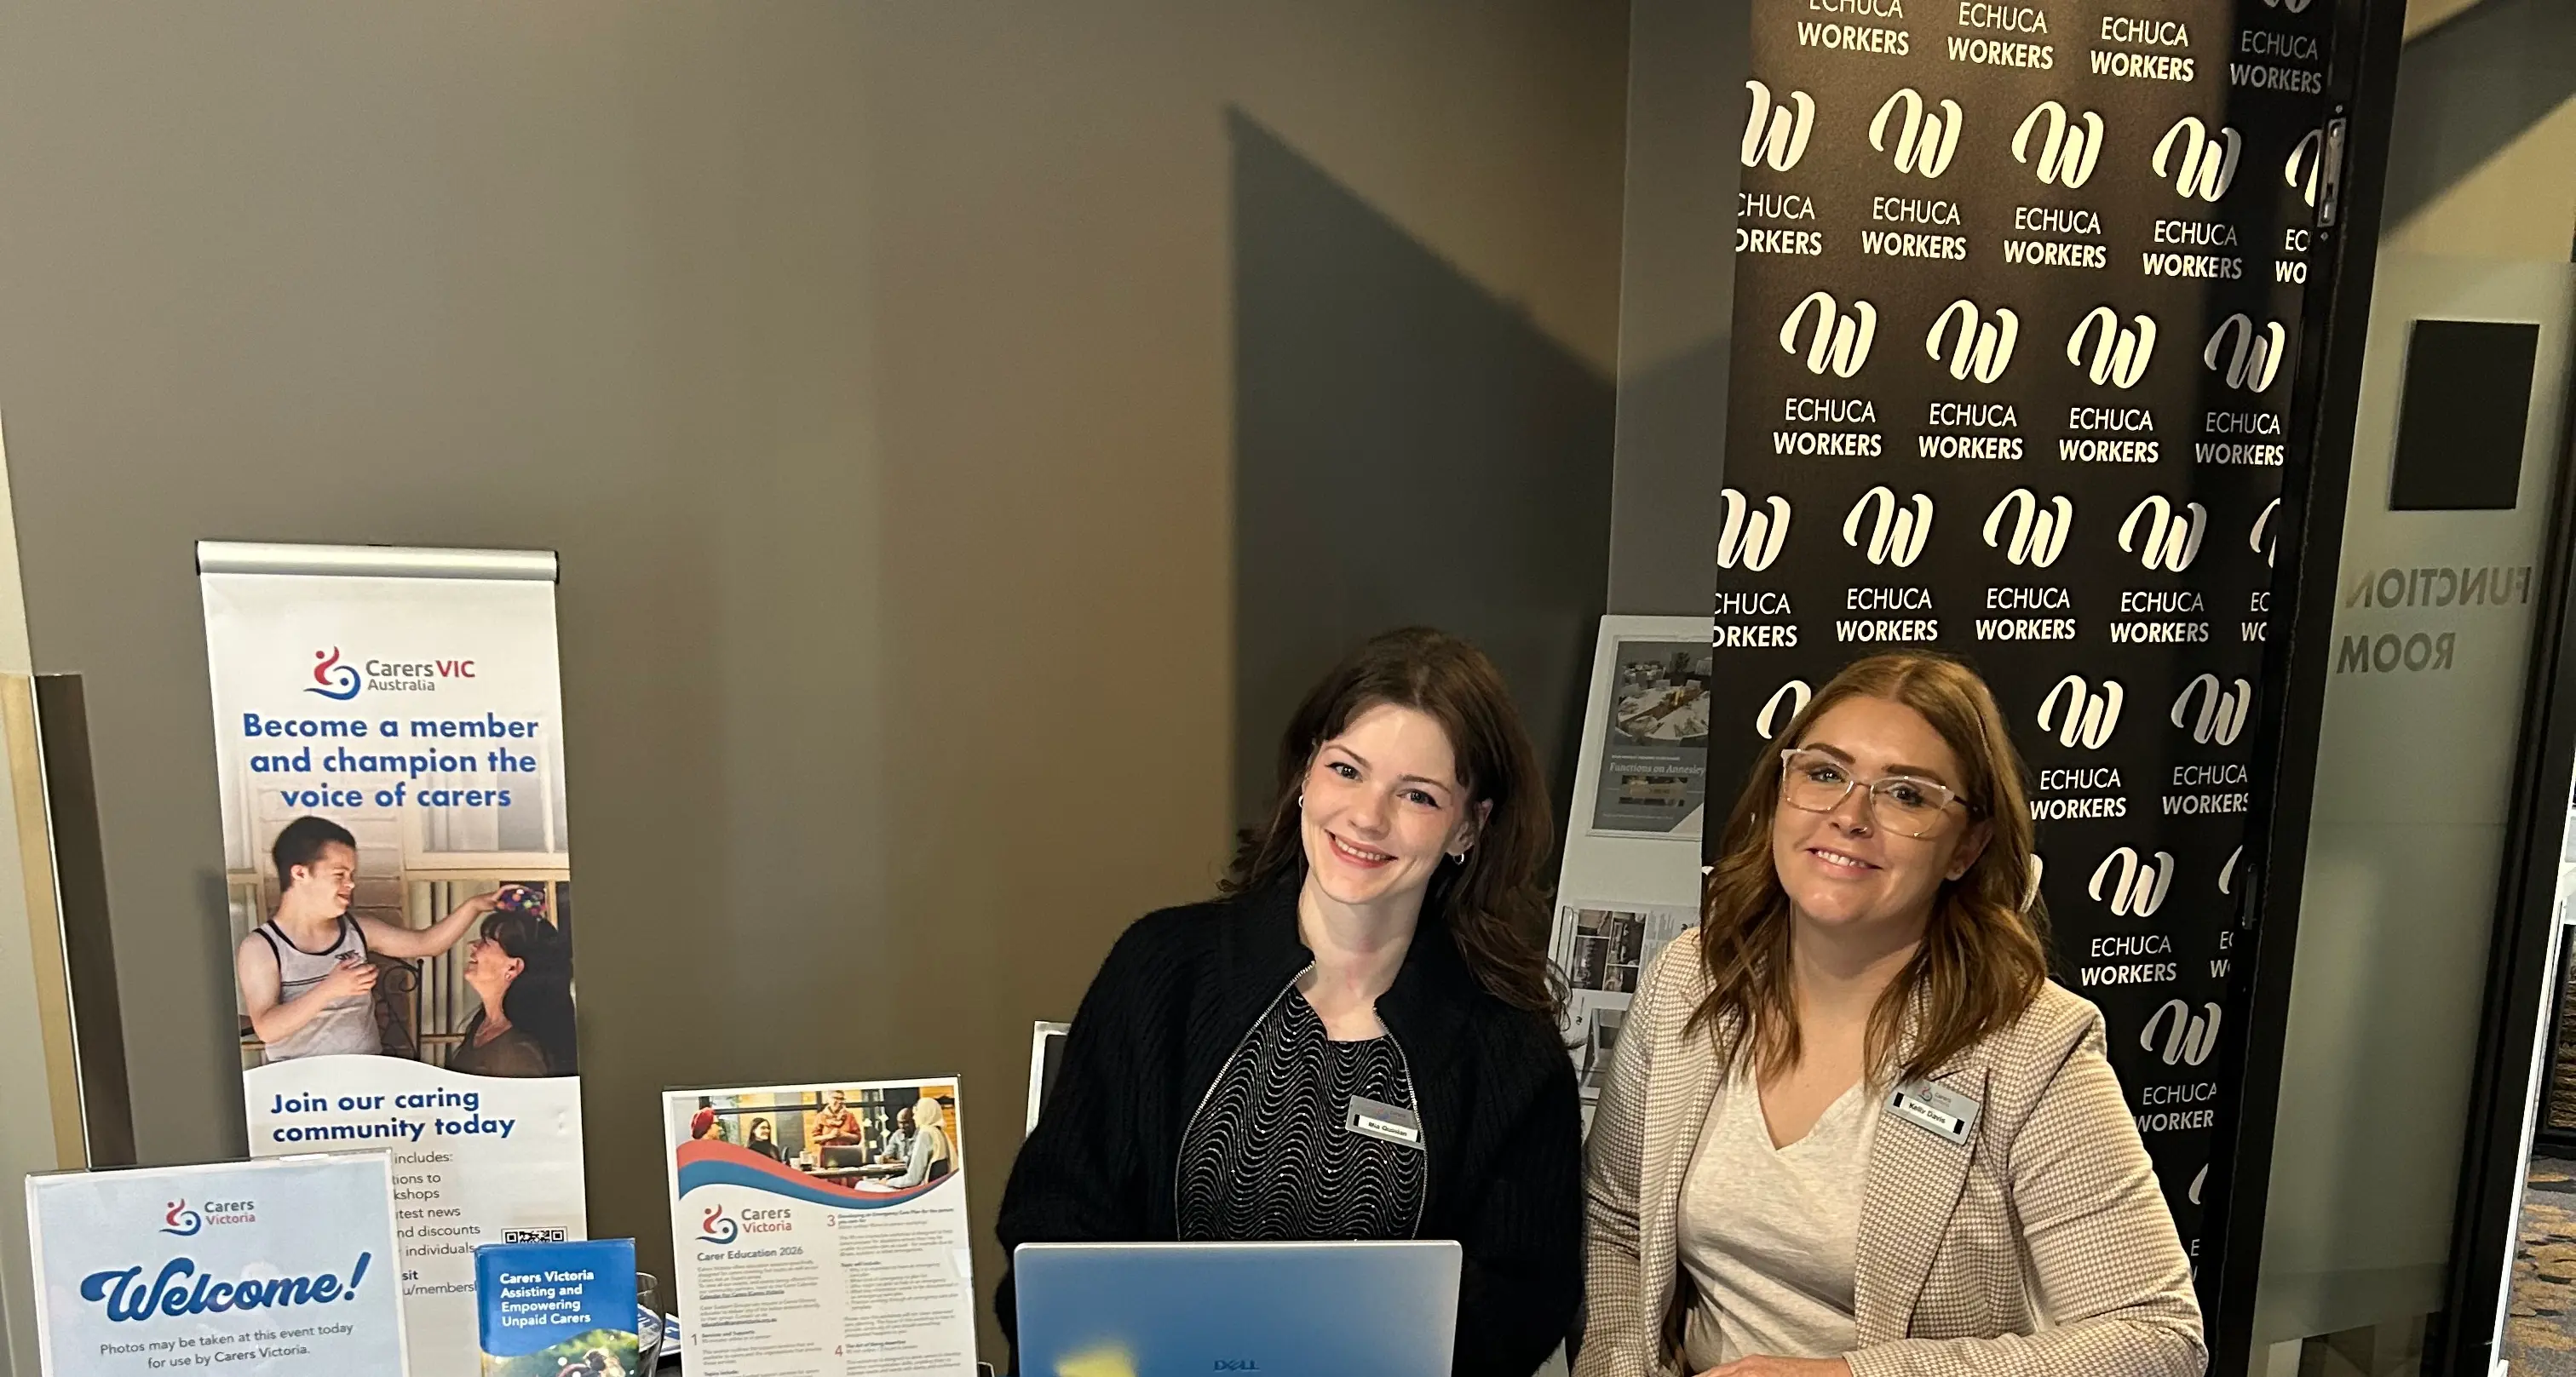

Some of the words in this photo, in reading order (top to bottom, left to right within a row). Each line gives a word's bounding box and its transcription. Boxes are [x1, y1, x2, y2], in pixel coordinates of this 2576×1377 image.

[1810, 0, 1902, 18] ECHUCA
[1959, 2, 2047, 33] ECHUCA
[1798, 22, 1908, 55] WORKERS
[2102, 17, 2188, 47] ECHUCA
[1948, 37, 2053, 69] WORKERS
[2242, 31, 2318, 60] ECHUCA
[2090, 50, 2194, 82] WORKERS
[2230, 63, 2321, 94] WORKERS
[1738, 193, 1814, 220] HUCA
[1873, 197, 1960, 225] ECHUCA
[2015, 208, 2101, 234] ECHUCA
[1736, 229, 1821, 255] ORKERS
[2154, 221, 2235, 245] ECHUCA
[1862, 231, 1966, 260] WORKERS
[2004, 240, 2106, 268] WORKERS
[2143, 253, 2241, 278] WORKERS
[1785, 399, 1876, 422] ECHUCA
[1929, 404, 2016, 427] ECHUCA
[2070, 408, 2153, 431] ECHUCA
[2206, 412, 2280, 434] ECHUCA
[1774, 432, 1881, 456] WORKERS
[1919, 436, 2022, 459] WORKERS
[2060, 439, 2159, 462] WORKERS
[2196, 444, 2284, 466] WORKERS
[1715, 593, 1791, 614] HUCA
[1848, 588, 1932, 609] ECHUCA
[1987, 588, 2070, 609] ECHUCA
[2121, 592, 2203, 612] ECHUCA
[1712, 625, 1797, 647] ORKERS
[1837, 620, 1937, 641] WORKERS
[1976, 619, 2075, 640] WORKERS
[2111, 623, 2208, 642] WORKERS
[366, 660, 434, 677] Carers
[436, 661, 475, 678] VIC
[368, 679, 434, 691] Australia
[244, 714, 367, 737] Become
[380, 721, 398, 737] a
[411, 713, 538, 737] member
[250, 747, 310, 772] and
[324, 747, 476, 779] champion
[488, 747, 536, 772] the
[2041, 768, 2120, 789] ECHUCA
[2174, 765, 2247, 785] ECHUCA
[280, 783, 362, 807] voice
[376, 782, 405, 806] of
[417, 789, 511, 807] carers
[2030, 797, 2126, 819] WORKERS
[2091, 936, 2171, 956] ECHUCA
[2081, 963, 2176, 986] WORKERS
[271, 1093, 327, 1113] Join
[338, 1097, 384, 1110] our
[395, 1087, 479, 1111] caring
[2143, 1083, 2217, 1104] ECHUCA
[273, 1117, 425, 1142] community
[435, 1114, 515, 1138] today
[2136, 1109, 2215, 1133] WORKER
[394, 1151, 454, 1164] includes:
[393, 1176, 423, 1185] tions
[394, 1188, 440, 1202] kshops
[204, 1202, 254, 1213] Carers
[396, 1208, 423, 1219] test
[428, 1208, 461, 1217] news
[742, 1209, 791, 1223] Carers
[206, 1214, 255, 1225] Victoria
[743, 1220, 791, 1233] Victoria
[827, 1214, 836, 1226] 3
[397, 1226, 414, 1239] nd
[418, 1225, 480, 1236] discounts
[405, 1242, 475, 1257] individuals
[697, 1253, 725, 1261] Carer
[727, 1250, 777, 1259] Education
[402, 1270, 418, 1280] sit
[500, 1273, 541, 1284] Carers
[544, 1270, 594, 1282] Victoria
[81, 1252, 371, 1322] Welcome!
[402, 1281, 477, 1296] u/members
[501, 1287, 555, 1299] Assisting
[559, 1283, 582, 1295] and
[502, 1300, 580, 1314] Empowering
[502, 1314, 546, 1328] Unpaid
[550, 1313, 590, 1324] Carers
[101, 1344, 145, 1355] Photos
[149, 1341, 175, 1351] may
[179, 1337, 195, 1347] be
[199, 1334, 234, 1345] taken
[239, 1333, 250, 1342] at
[254, 1330, 277, 1340] this
[280, 1328, 314, 1339] event
[318, 1322, 353, 1335] today
[691, 1334, 697, 1345] 1
[148, 1357, 165, 1368] for
[170, 1357, 191, 1367] use
[195, 1354, 210, 1366] by
[215, 1351, 256, 1362] Carers
[259, 1347, 310, 1357] Victoria.
[835, 1345, 842, 1357] 4
[1213, 1360, 1259, 1371] DELL
